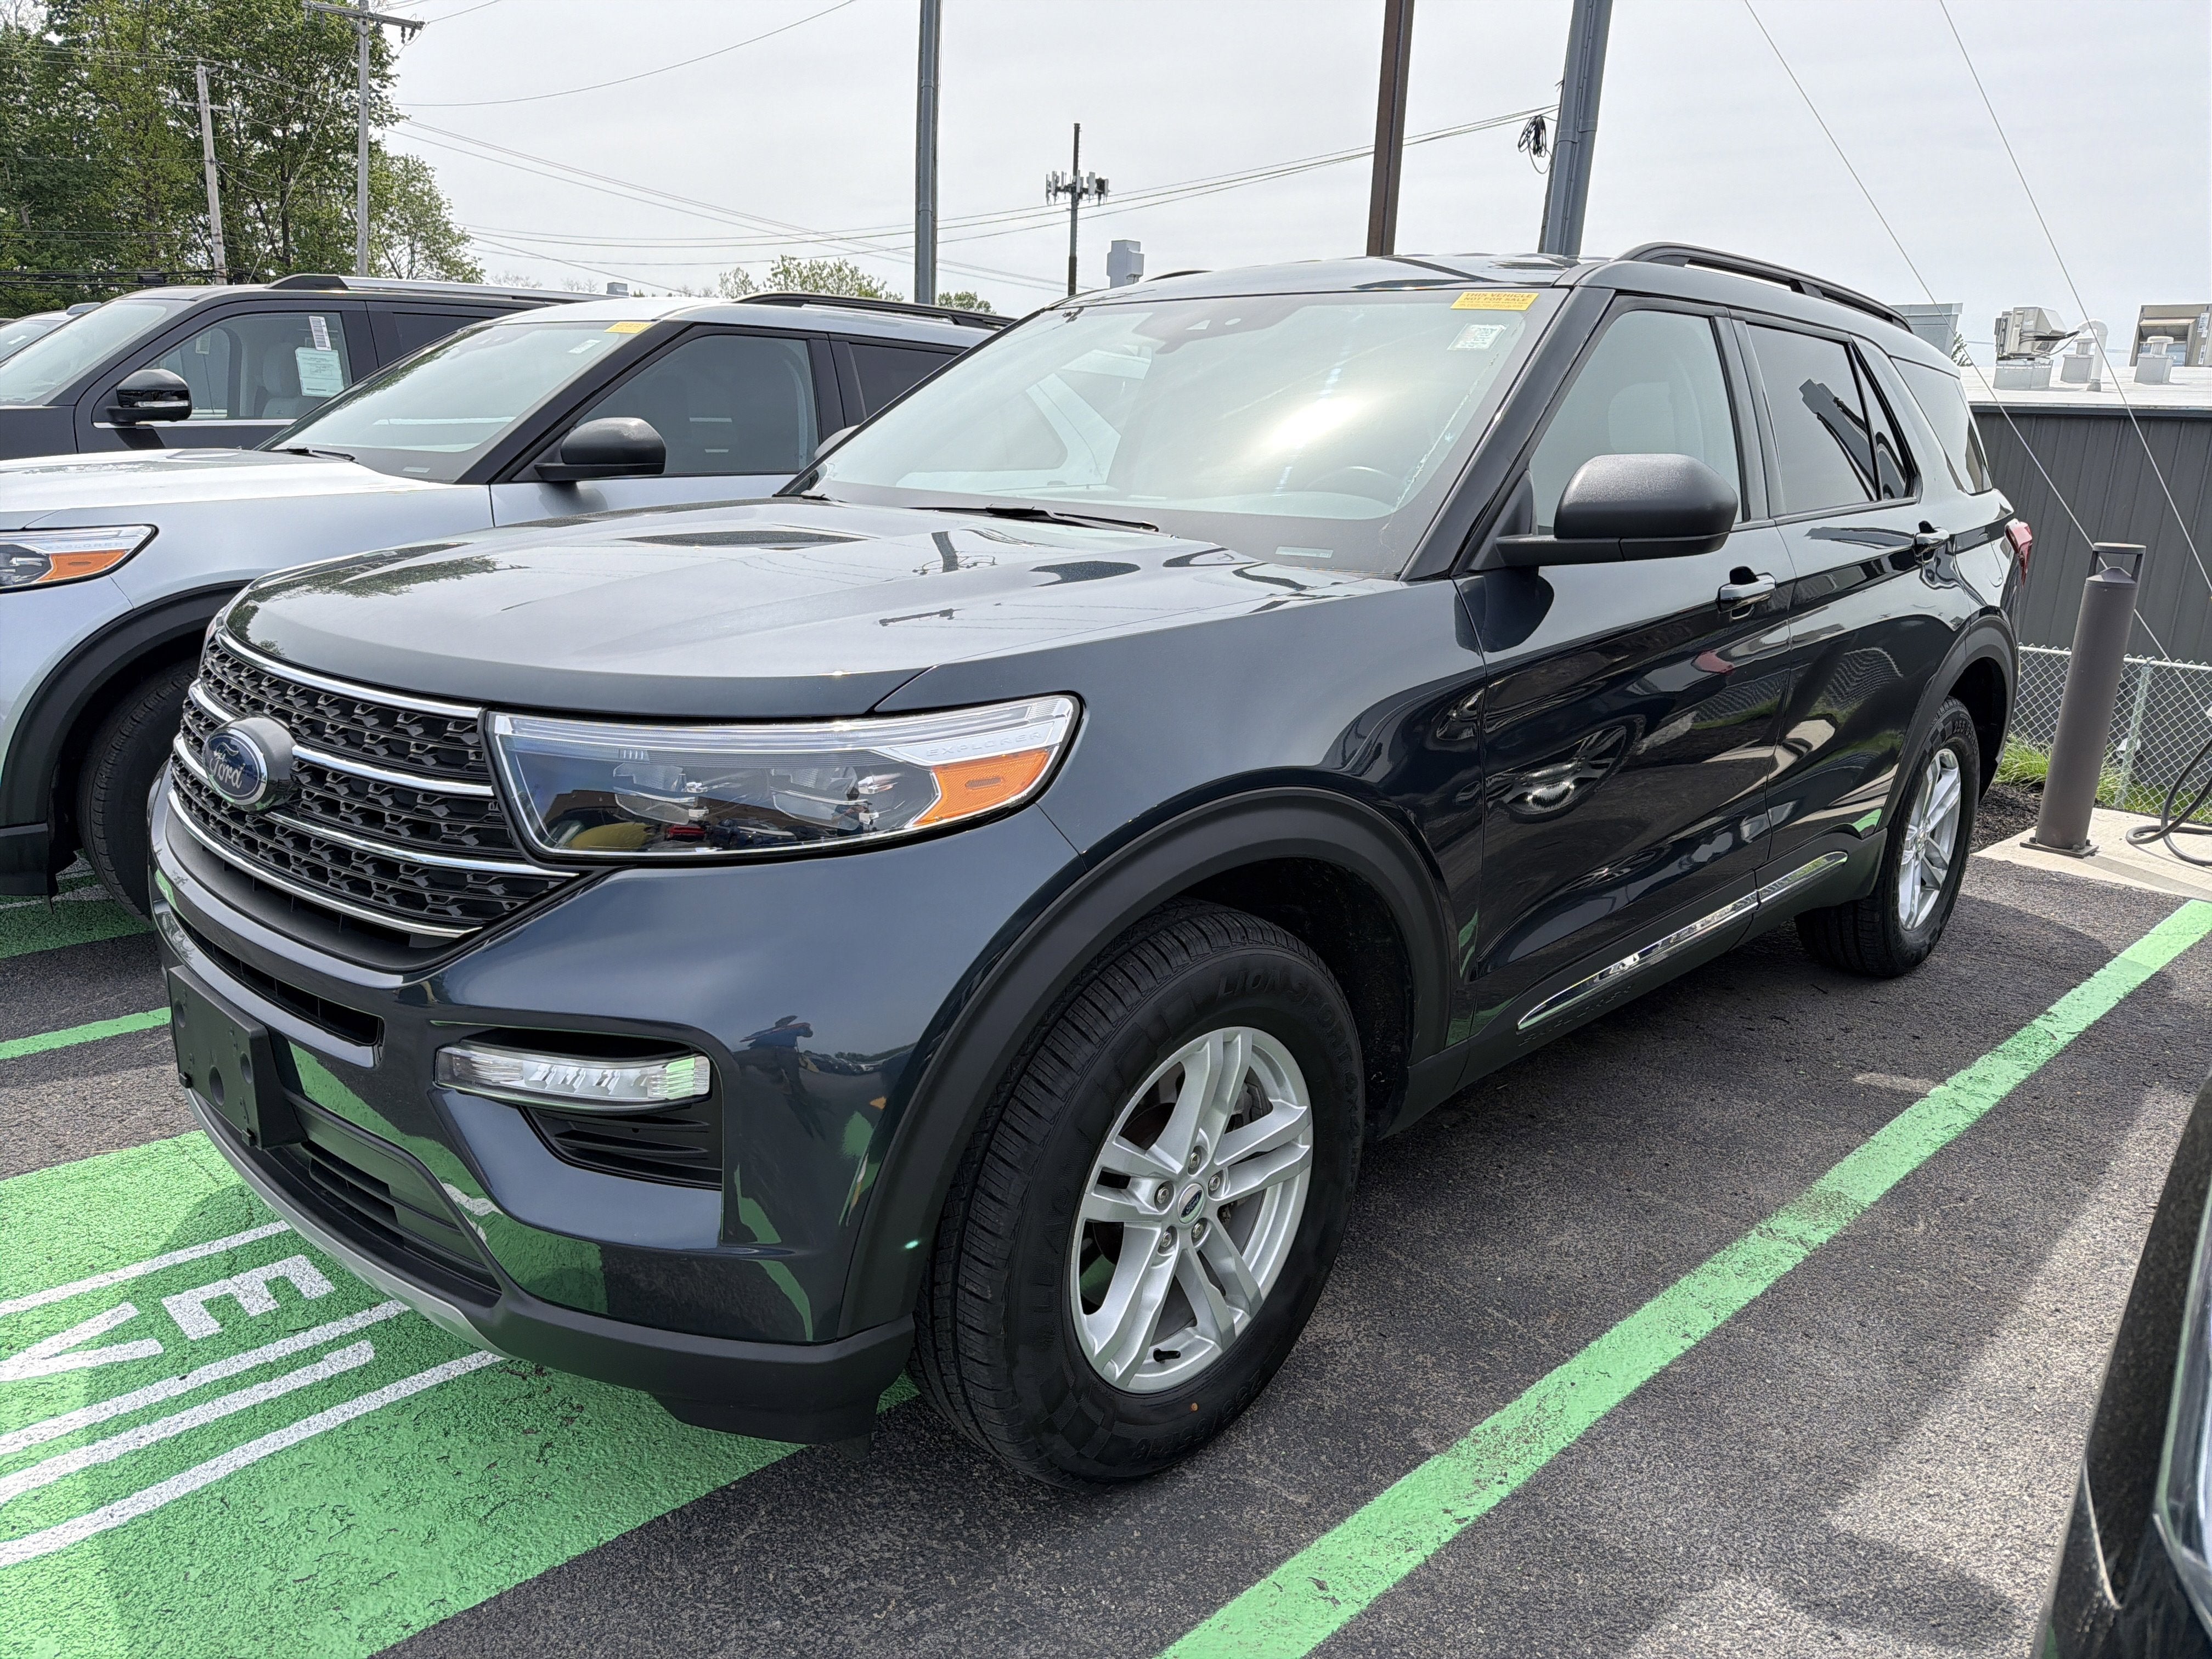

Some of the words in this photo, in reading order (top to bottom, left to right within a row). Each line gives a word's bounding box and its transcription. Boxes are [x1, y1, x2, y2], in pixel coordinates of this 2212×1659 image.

[209, 742, 246, 789] Ford
[926, 732, 1043, 757] EXPLORER
[1216, 968, 1286, 1001] LION
[1287, 979, 1353, 1062] SPORT
